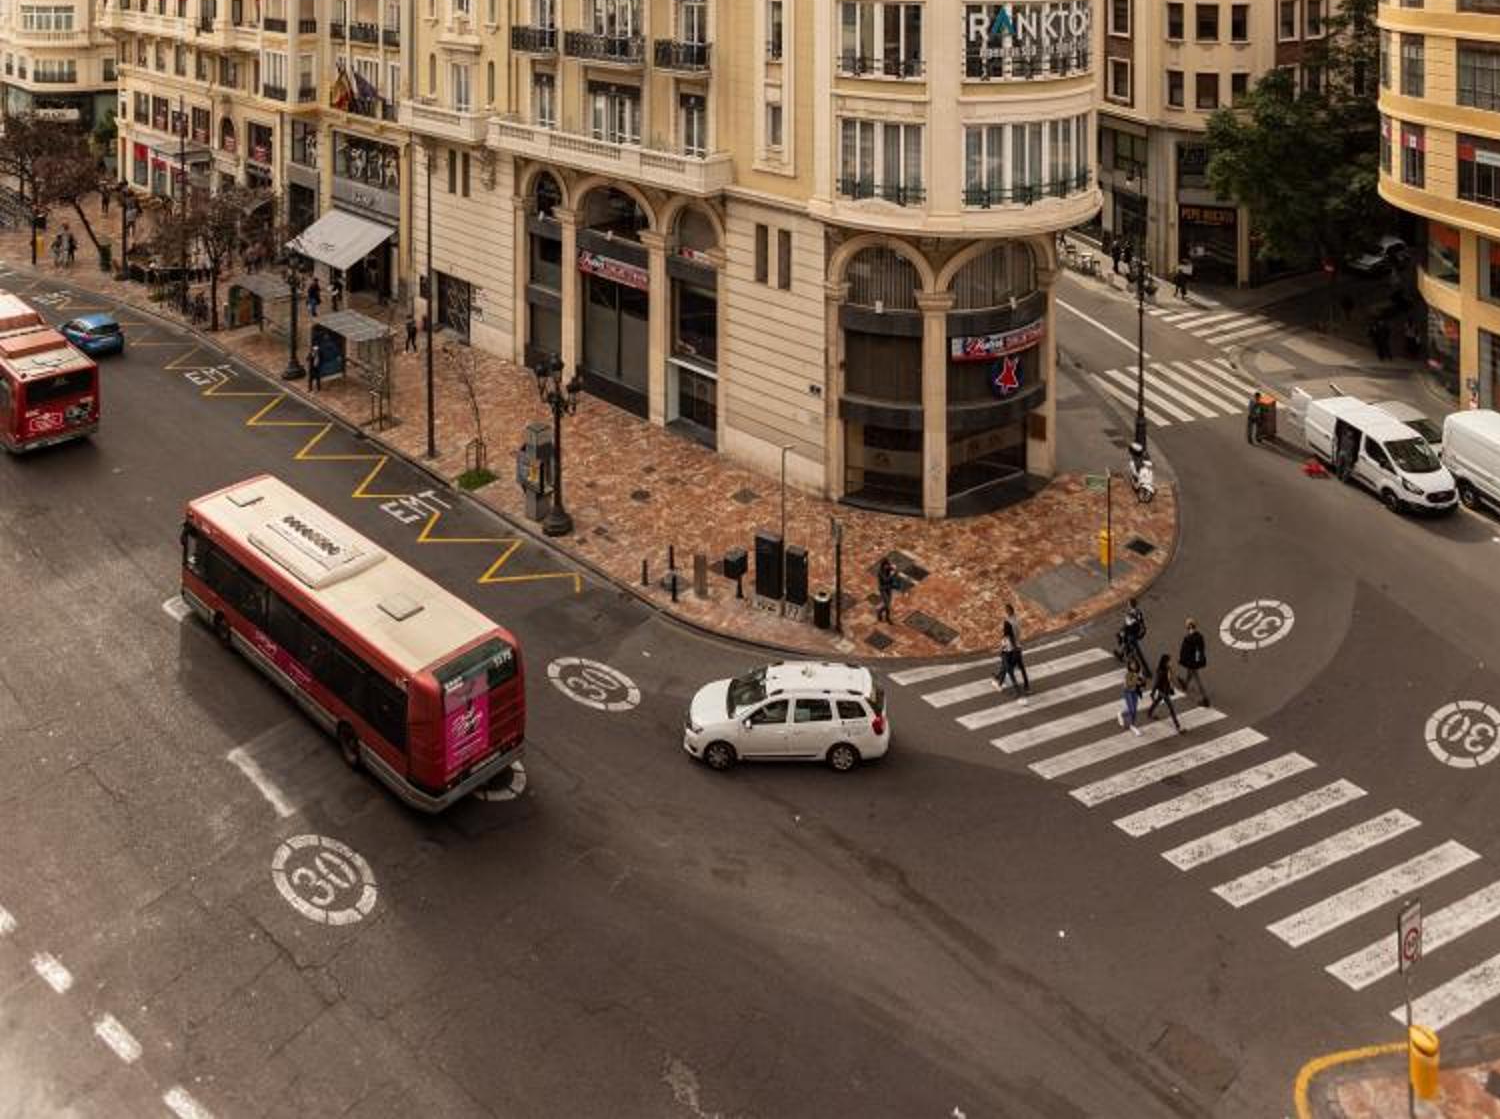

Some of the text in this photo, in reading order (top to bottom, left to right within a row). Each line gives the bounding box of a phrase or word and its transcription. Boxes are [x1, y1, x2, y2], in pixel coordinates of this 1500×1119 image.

[380, 490, 452, 523] EMT
[1235, 609, 1282, 638] 30
[567, 668, 621, 700] 30
[1442, 714, 1495, 753] 30
[292, 852, 357, 905] 30
